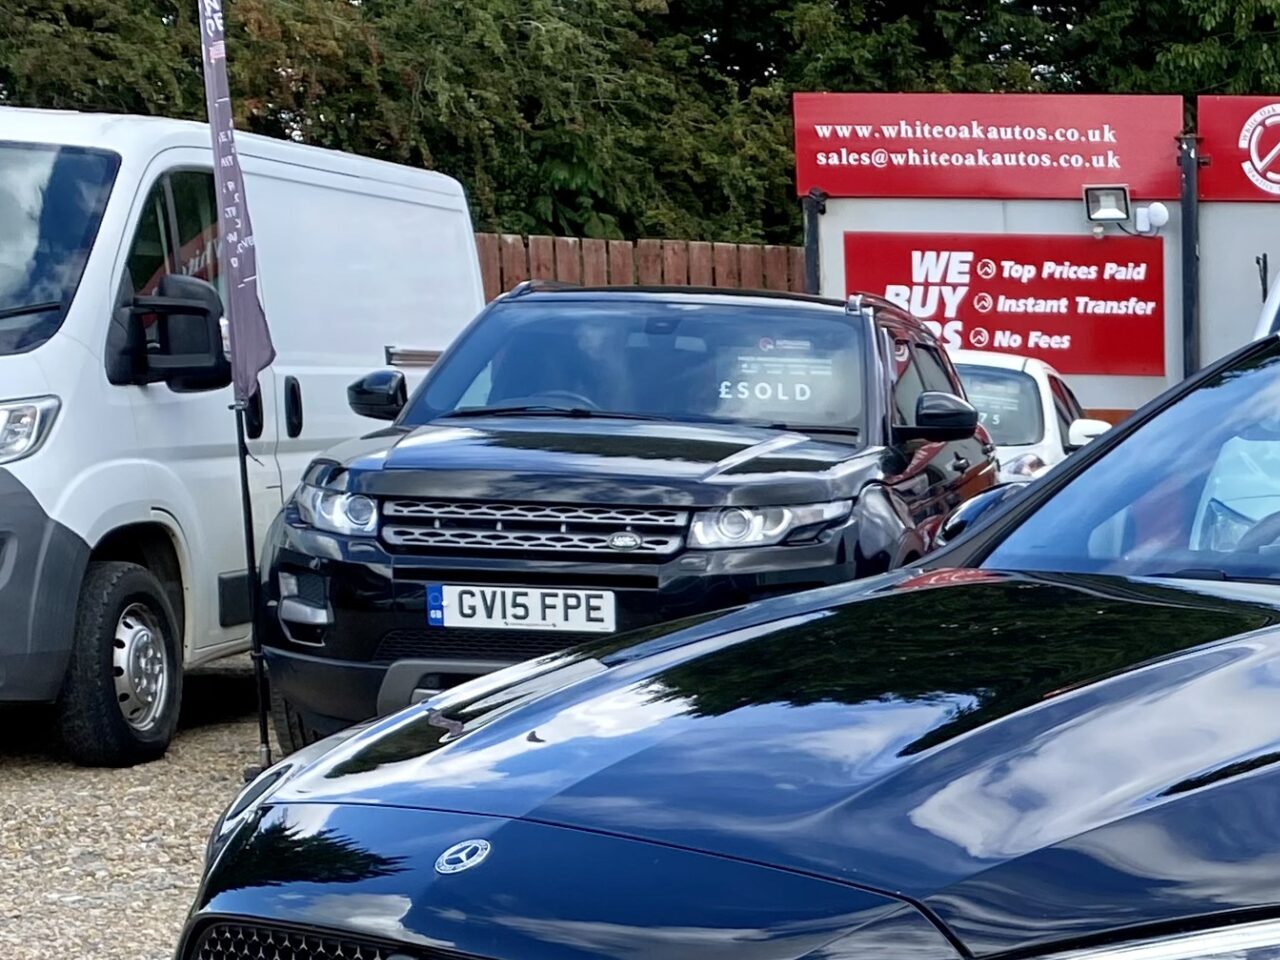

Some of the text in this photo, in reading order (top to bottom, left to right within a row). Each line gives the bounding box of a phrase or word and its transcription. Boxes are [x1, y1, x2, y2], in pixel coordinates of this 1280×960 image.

[814, 120, 1117, 144] www.whiteoakautos.co.uk
[816, 147, 1121, 169] sales@whiteoakautos.co.uk
[911, 250, 974, 283] WE
[1000, 260, 1147, 282] Top Prices Paid
[884, 285, 969, 318] BUY
[996, 295, 1156, 315] Instant Transfer
[993, 330, 1071, 349] No Fees
[719, 381, 811, 401] £SOLD
[457, 589, 605, 623] GV15 FPE
